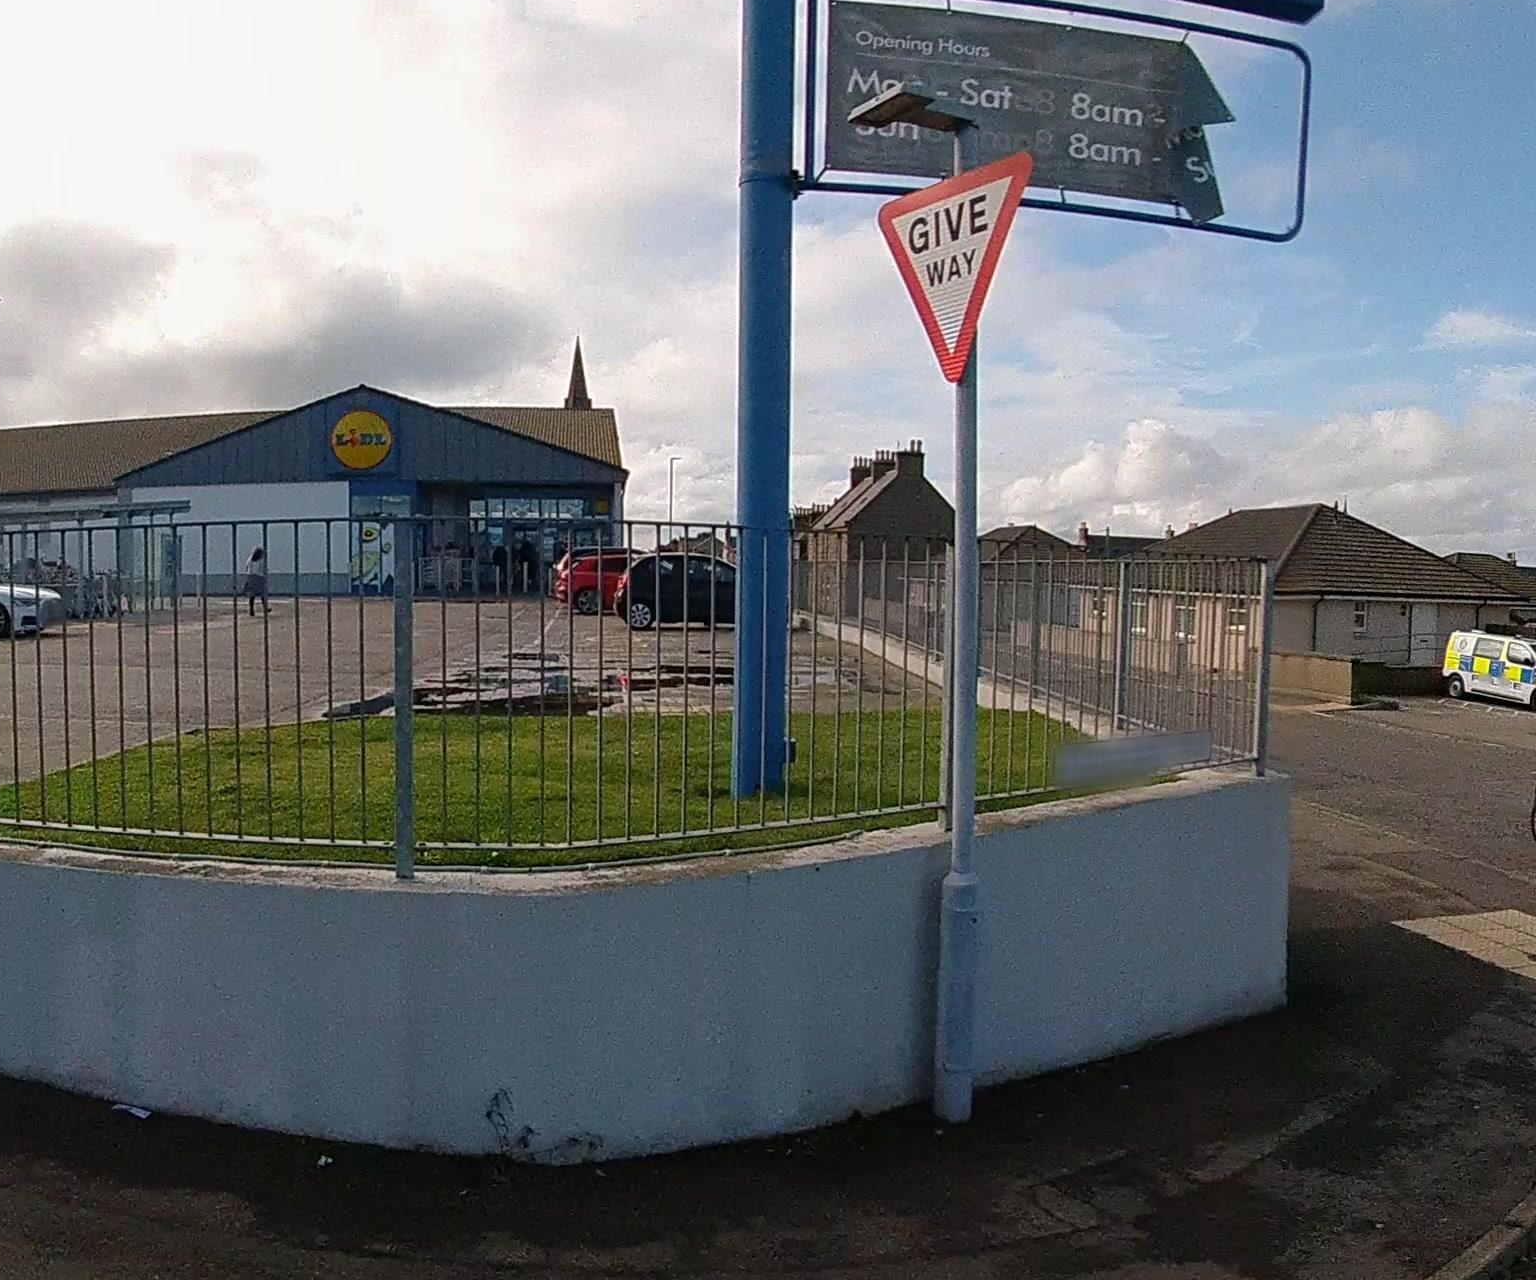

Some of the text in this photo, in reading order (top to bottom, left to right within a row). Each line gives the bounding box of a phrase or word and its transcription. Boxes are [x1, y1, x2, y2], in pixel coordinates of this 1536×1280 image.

[855, 30, 991, 58] Opening Hours
[846, 67, 904, 96] Mo
[960, 78, 1013, 110] Sat
[1070, 92, 1144, 127] 8am
[1068, 132, 1142, 166] 8am
[908, 193, 989, 255] GIVE
[925, 248, 977, 287] WAY
